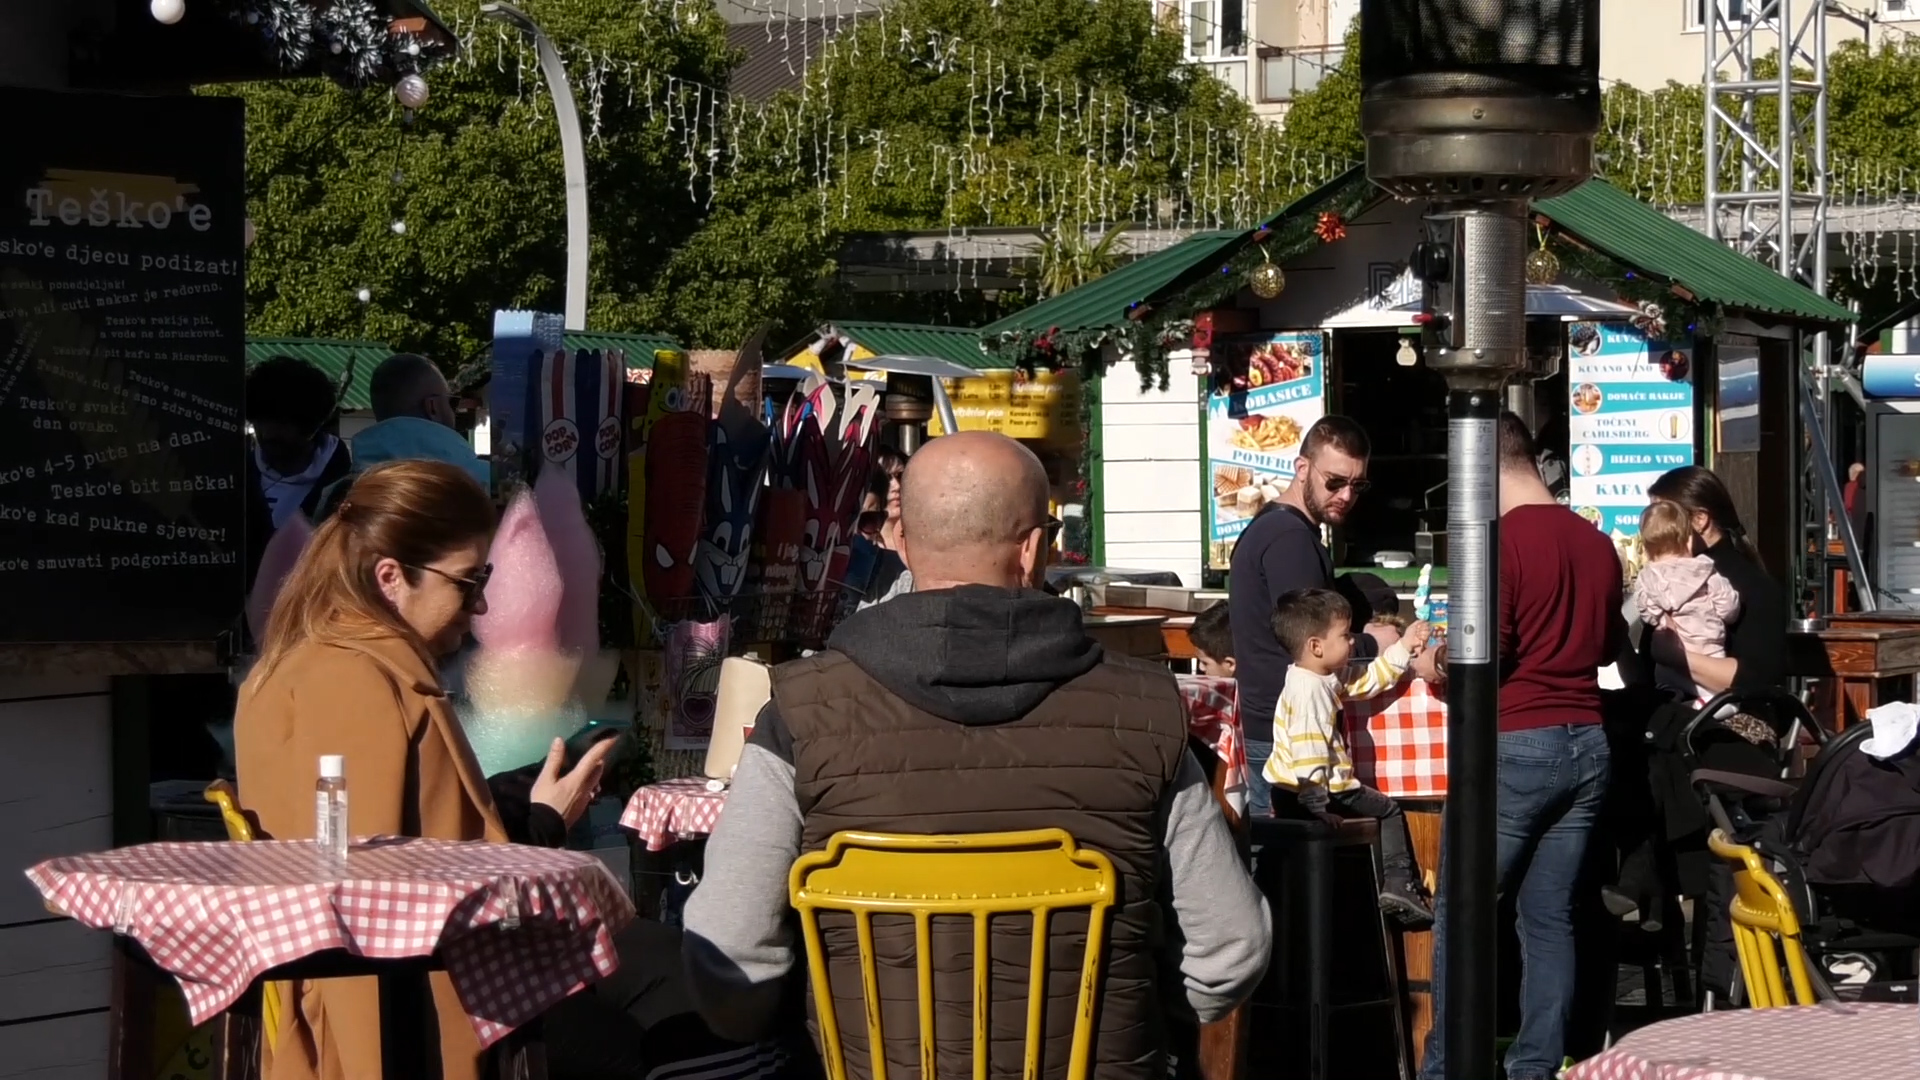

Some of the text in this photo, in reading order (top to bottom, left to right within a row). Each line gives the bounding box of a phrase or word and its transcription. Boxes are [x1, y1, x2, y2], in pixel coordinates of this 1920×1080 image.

[26, 187, 212, 231] Teško'e
[0, 238, 238, 275] sko'e djecu podizat!
[49, 279, 125, 292] ponedjeljak!
[144, 288, 158, 303] je
[163, 282, 223, 298] redovno.
[151, 315, 189, 327] rakije
[111, 329, 136, 339] vode
[141, 330, 154, 339] ne
[125, 348, 150, 360] kafu
[1578, 365, 1653, 373] KUVANO VINO
[173, 387, 187, 399] ne
[1233, 384, 1312, 412] KOBASICE
[1649, 391, 1685, 401] RAKIJE
[19, 397, 77, 412] Tesko'e
[33, 416, 118, 433] dan ovako.
[1596, 417, 1636, 427] TOČENI
[545, 426, 567, 445] POP
[599, 424, 616, 440] POP
[44, 454, 76, 476] 4-5
[84, 446, 128, 469] pute
[137, 440, 161, 454] na
[169, 430, 212, 449] dan.
[548, 432, 577, 458] CORN
[1610, 454, 1685, 464] BIJELO VINO
[51, 474, 235, 500] Tesko'e bit mačka!
[1596, 484, 1642, 495] KAFA
[46, 509, 79, 527] kad
[89, 514, 148, 534] pukne
[156, 521, 226, 542] sjever!
[37, 554, 103, 570] smuvati
[111, 551, 237, 570] podgoričanku!
